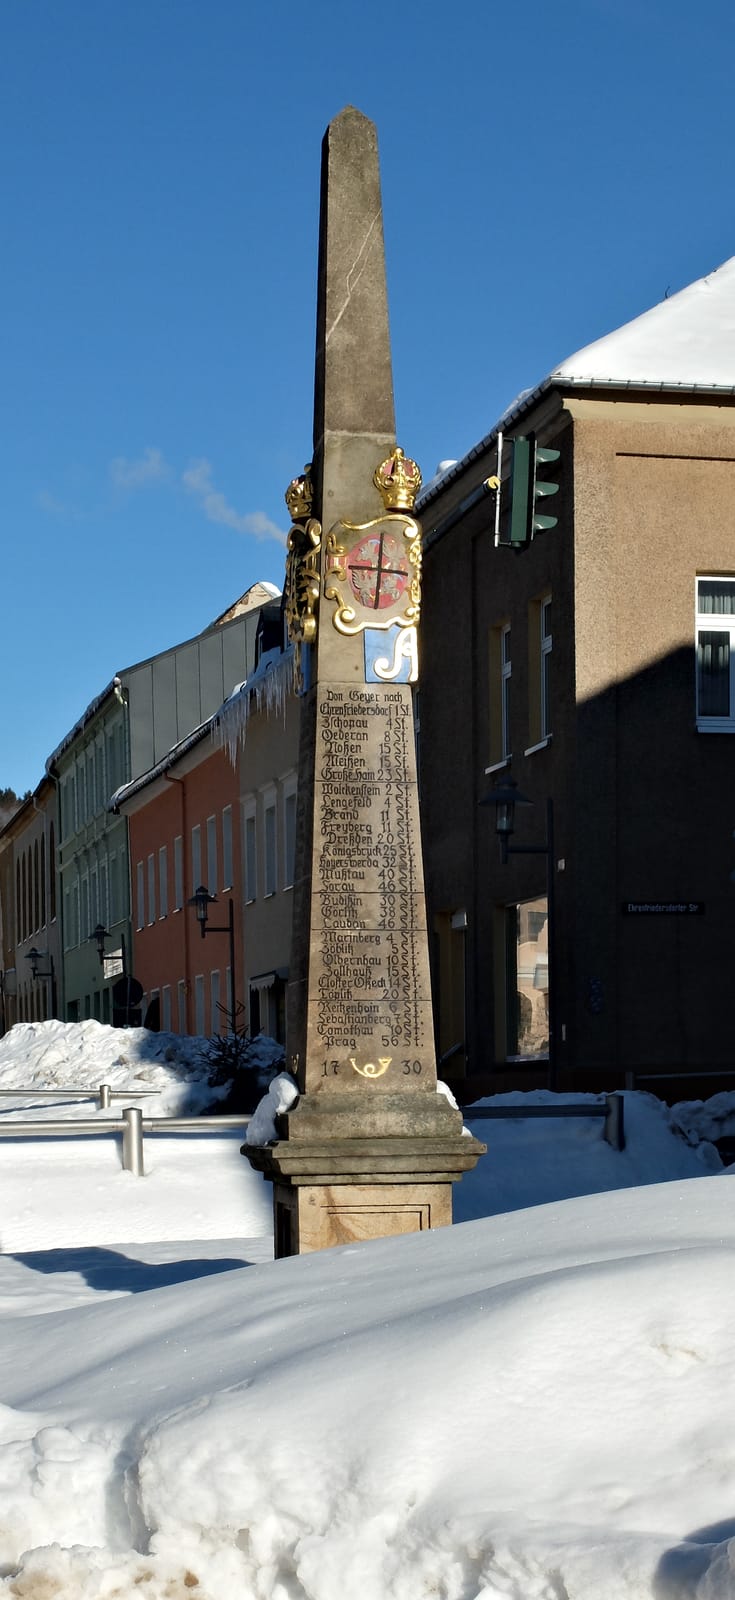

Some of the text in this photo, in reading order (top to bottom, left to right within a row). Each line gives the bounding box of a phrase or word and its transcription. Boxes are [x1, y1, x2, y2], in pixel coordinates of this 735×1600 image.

[349, 690, 380, 703] Geyer
[384, 692, 403, 703] nach
[320, 703, 393, 718] Ehrenfriedersdorf
[386, 719, 393, 729] 4
[394, 717, 408, 729] St.
[322, 729, 408, 742] Oederan 8 St.
[379, 743, 391, 754] 15
[393, 743, 408, 754] St.
[380, 756, 391, 768] 15
[394, 755, 409, 768] St.
[377, 769, 392, 780] 23
[395, 768, 411, 781] St.
[322, 783, 412, 796] Wolckenstein 2 St.
[321, 795, 412, 810] Lengefeld 4 St.
[320, 808, 413, 821] Brand 11 St.
[321, 820, 413, 835] Freyberg 11 St.
[378, 833, 394, 844] 20
[397, 833, 414, 844] St.
[383, 845, 397, 856] 25
[399, 845, 415, 856] St.
[320, 855, 416, 869] Hoyerswerda 32 St.
[378, 869, 394, 880] 40
[399, 869, 416, 880] St.
[320, 880, 416, 892] Sorau 46 St.
[380, 894, 396, 905] 30
[400, 894, 417, 906] St.
[380, 906, 396, 918] 38
[400, 906, 417, 918] St.
[378, 918, 395, 929] 46
[400, 918, 417, 929] St.
[386, 933, 394, 944] 4
[401, 931, 418, 943] St.
[392, 944, 398, 954] 5
[401, 943, 419, 954] St.
[322, 954, 419, 966] Olbernhau 10 St.
[387, 966, 399, 977] 15
[402, 966, 420, 977] St.
[389, 978, 401, 988] 14
[402, 977, 421, 988] St.
[382, 989, 399, 999] 20
[403, 987, 422, 1000] St.
[389, 1002, 398, 1013] 6
[404, 1002, 423, 1013] St.
[394, 1014, 400, 1024] 7
[404, 1013, 423, 1024] St.
[391, 1025, 402, 1035] 10
[404, 1024, 424, 1035] St.
[322, 1035, 424, 1051] Prag 56 St.
[321, 1060, 422, 1077] 17 30
